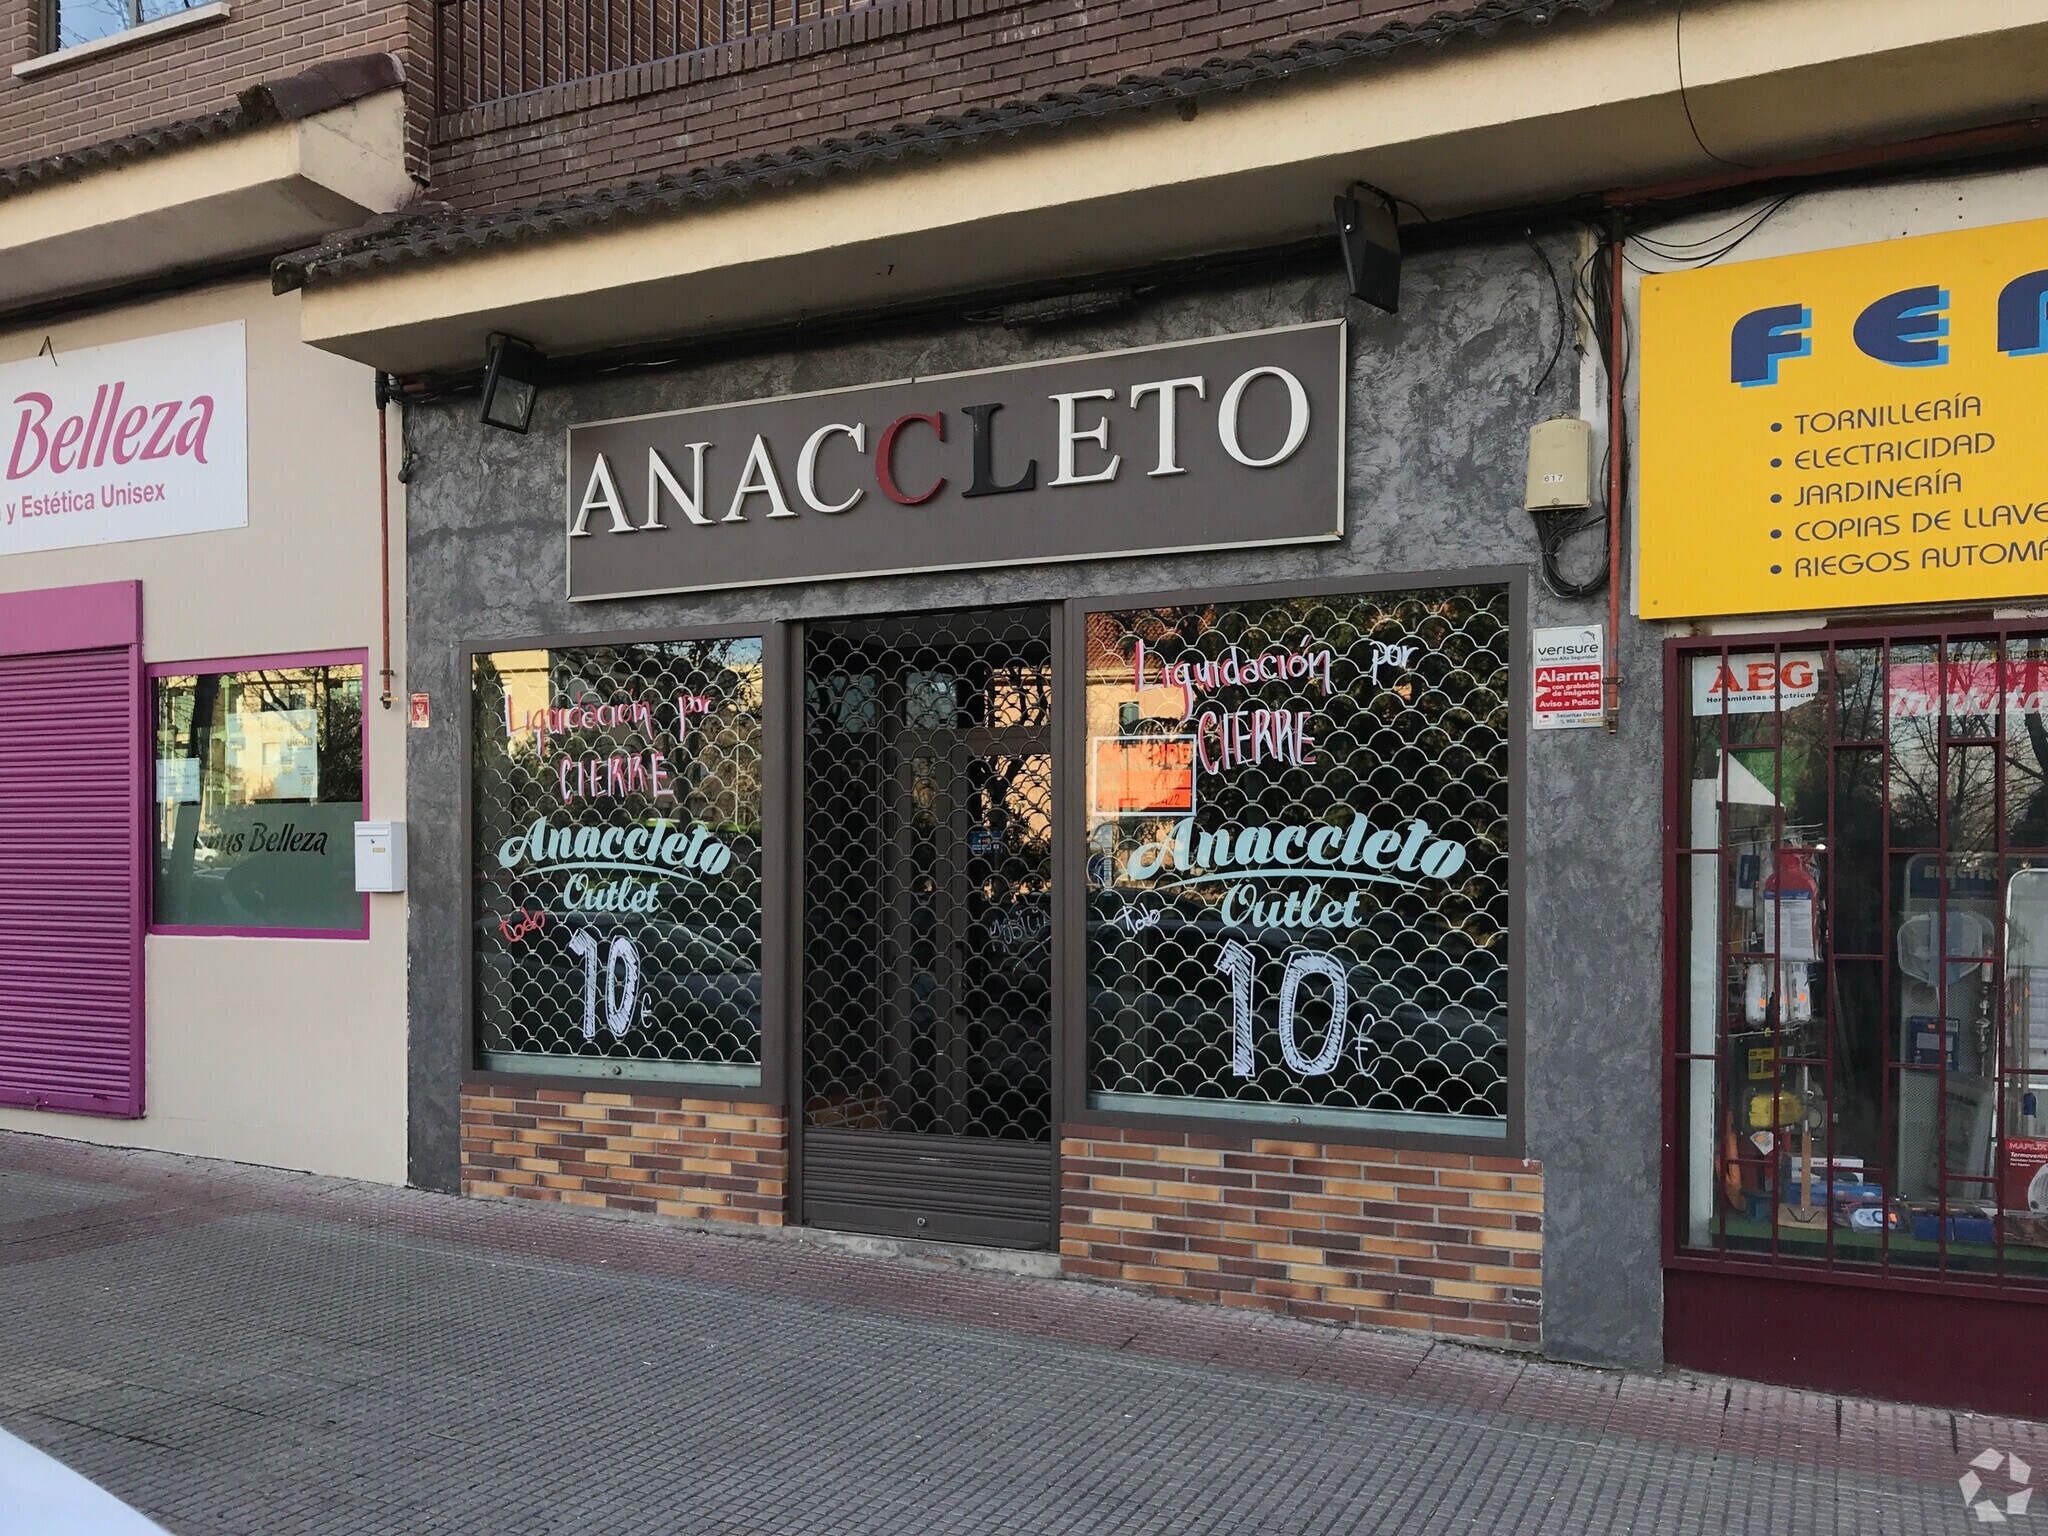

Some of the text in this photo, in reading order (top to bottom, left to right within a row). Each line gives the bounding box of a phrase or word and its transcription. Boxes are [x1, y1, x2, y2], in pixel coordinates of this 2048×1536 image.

[6, 381, 214, 480] Belleza
[1794, 393, 1981, 435] TORNILLERÍA
[569, 366, 1310, 537] ANACCLETO
[1794, 432, 1995, 470] ELECTRICIDAD
[1544, 474, 1563, 482] 617
[1794, 469, 1962, 507] JARDINERÍA
[6, 483, 165, 525] y Estética Unisex
[1794, 514, 1900, 542] COPIAS
[1913, 510, 1951, 534] DE
[1794, 550, 1909, 578] RIEGOS
[1370, 640, 1418, 685] por
[1538, 644, 1599, 656] verisure
[1538, 670, 1600, 682] Alarma
[1564, 689, 1599, 697] imágenes
[1566, 682, 1599, 690] grabación
[1709, 660, 1813, 693] AEG
[1539, 700, 1563, 708] Aviso
[1571, 698, 1599, 707] Policía
[1706, 694, 1767, 703] Heramientas
[679, 694, 715, 742] por
[1199, 708, 1317, 775] CIERRE
[560, 752, 674, 804] CIERRE
[249, 822, 328, 856] Belleza
[500, 815, 731, 875] Anaccleto
[1127, 812, 1466, 880] Anaccleto
[563, 873, 661, 912] Outlet
[1220, 883, 1362, 928] Outlet
